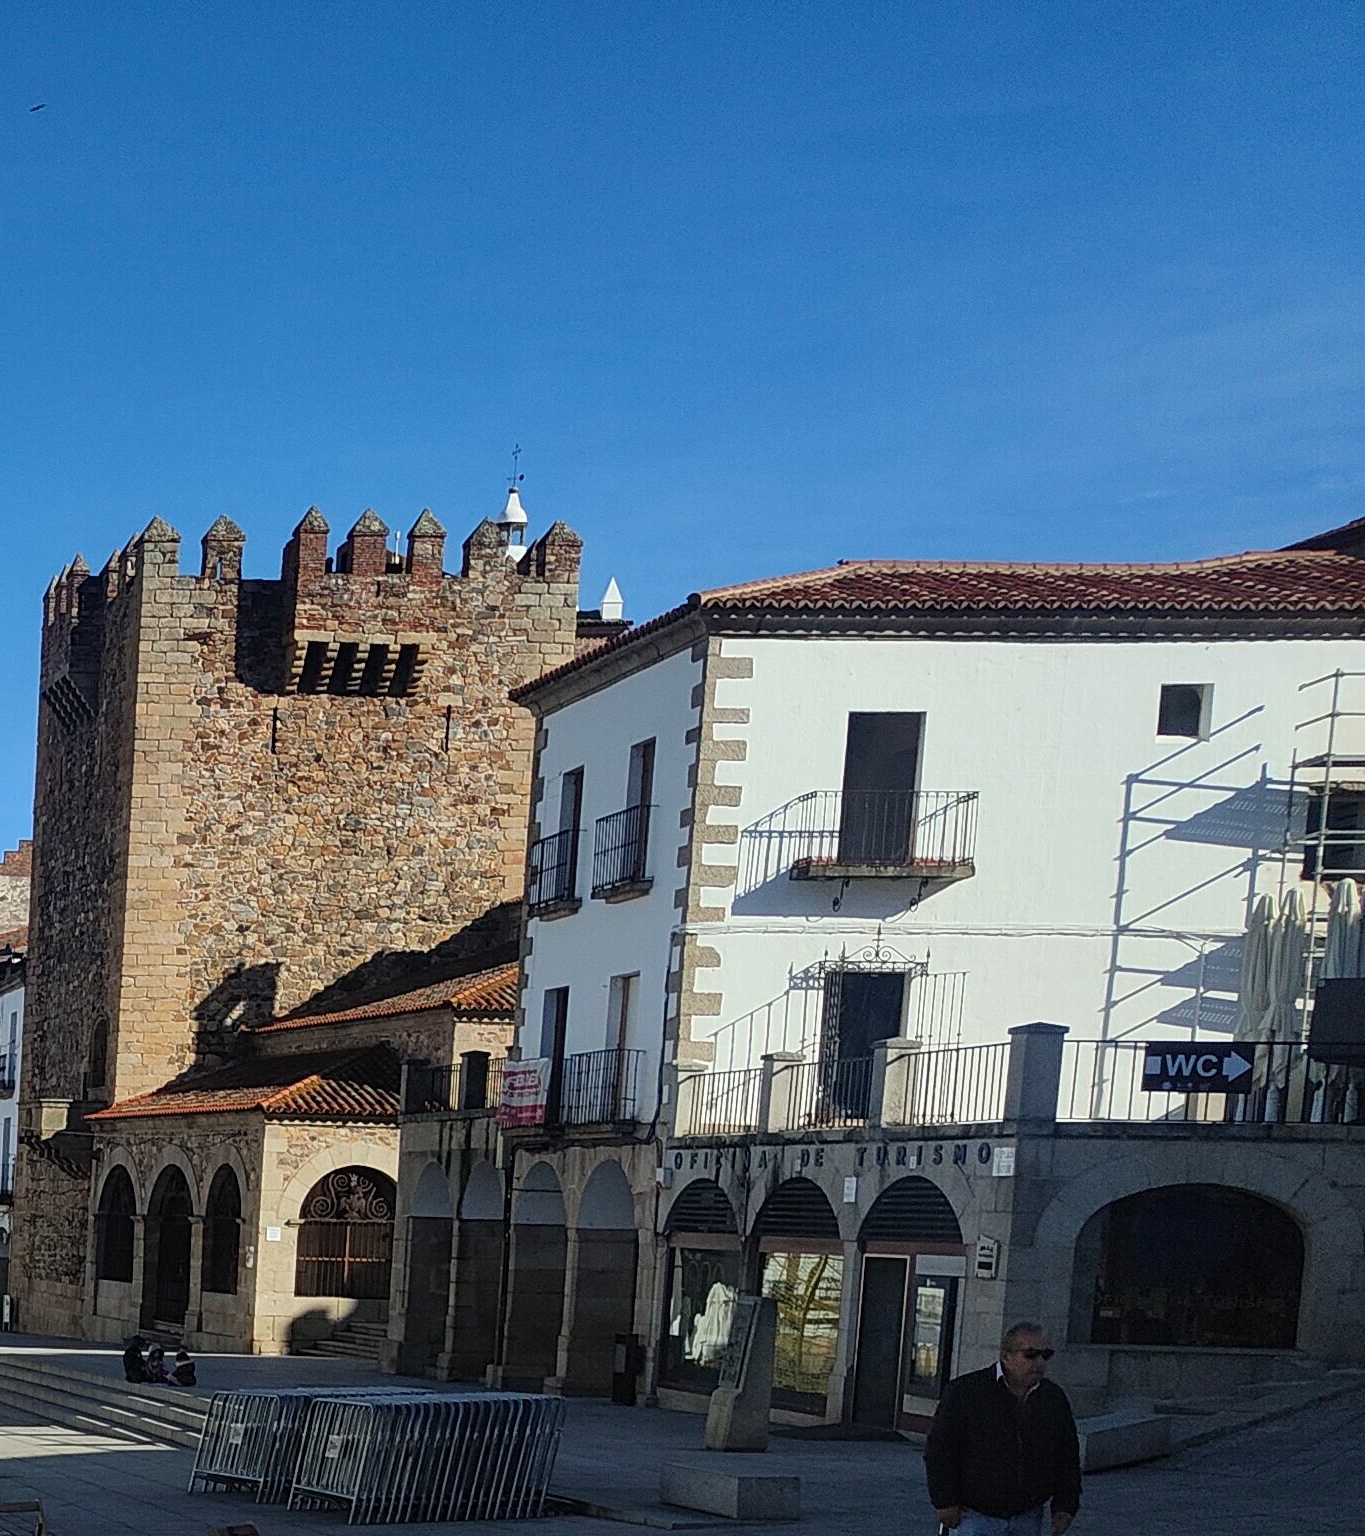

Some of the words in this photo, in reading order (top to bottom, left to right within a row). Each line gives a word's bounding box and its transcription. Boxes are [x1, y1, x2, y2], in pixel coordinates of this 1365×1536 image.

[1165, 1054, 1218, 1077] WC
[801, 1148, 825, 1167] DE
[857, 1142, 991, 1167] TURISMO
